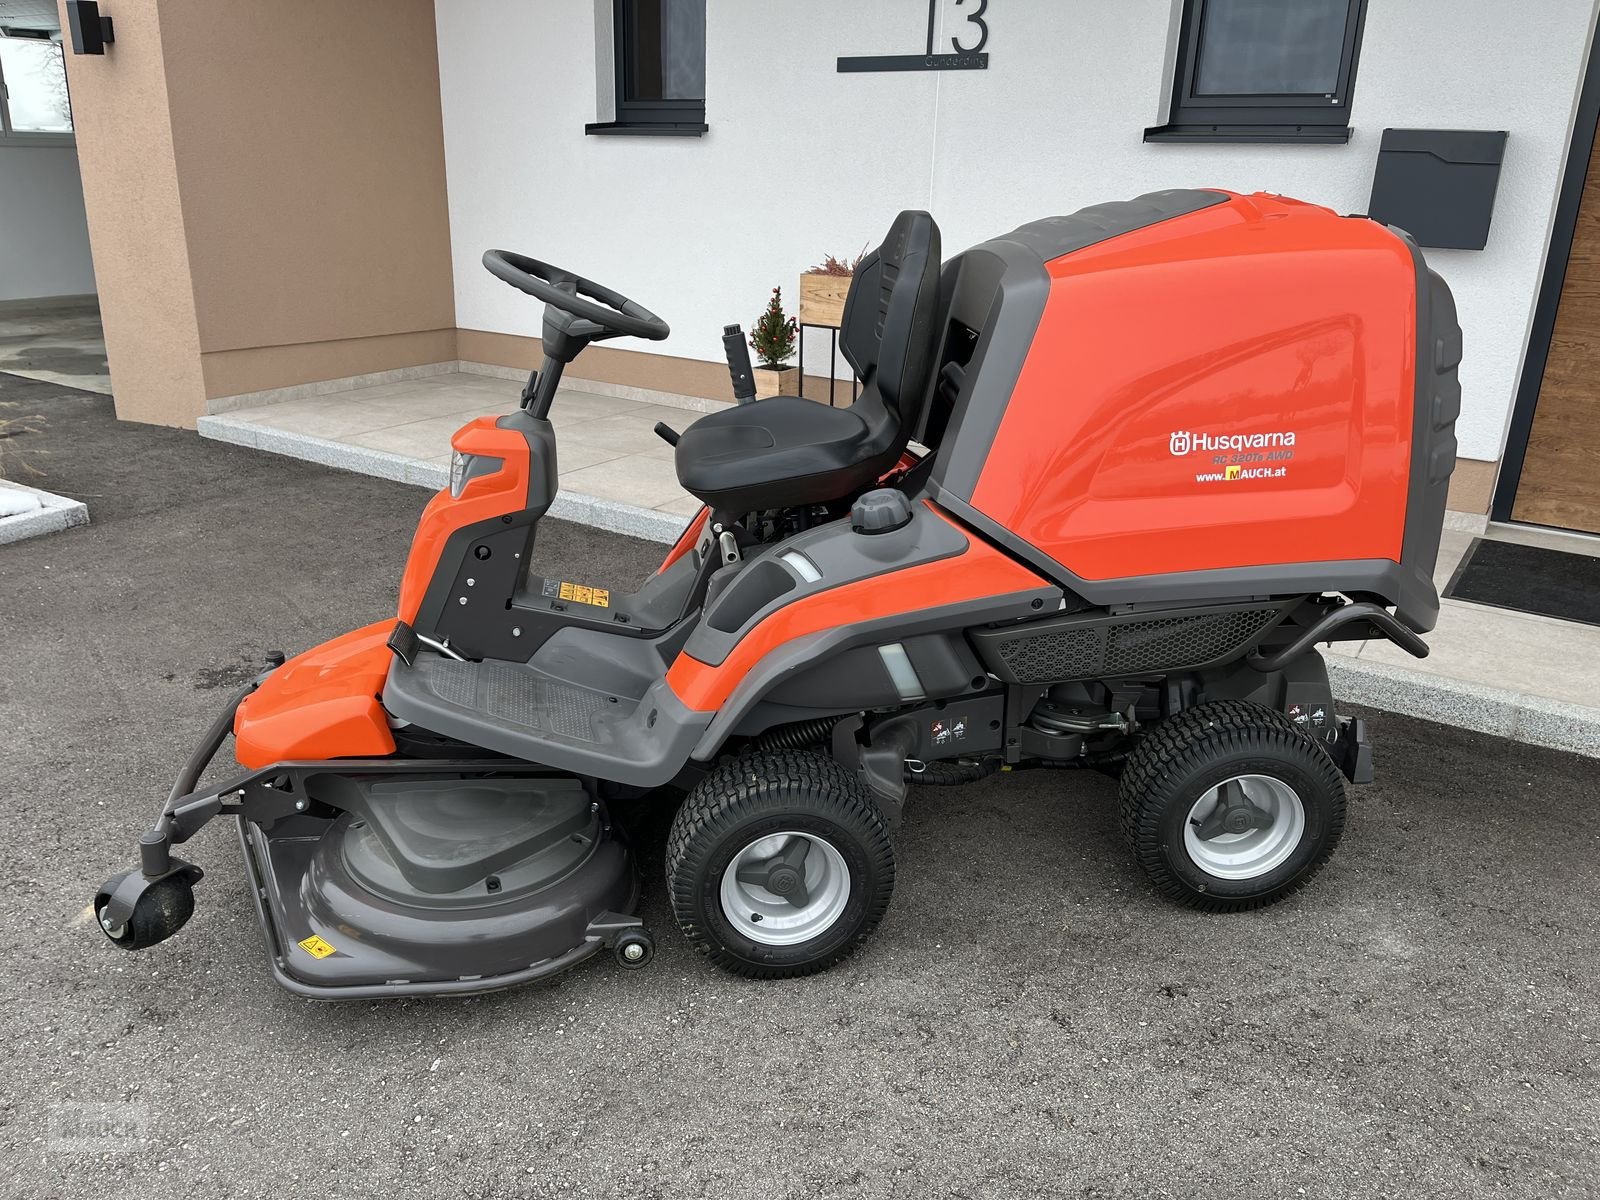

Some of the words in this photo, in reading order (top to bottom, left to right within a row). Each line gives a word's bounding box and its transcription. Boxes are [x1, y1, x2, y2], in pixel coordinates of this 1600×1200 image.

[925, 55, 985, 69] Gunderding
[1192, 431, 1296, 451] Husqvarna
[1212, 455, 1228, 465] RC
[1266, 450, 1294, 461] AWD
[1196, 466, 1287, 482] www.MAUCH.at
